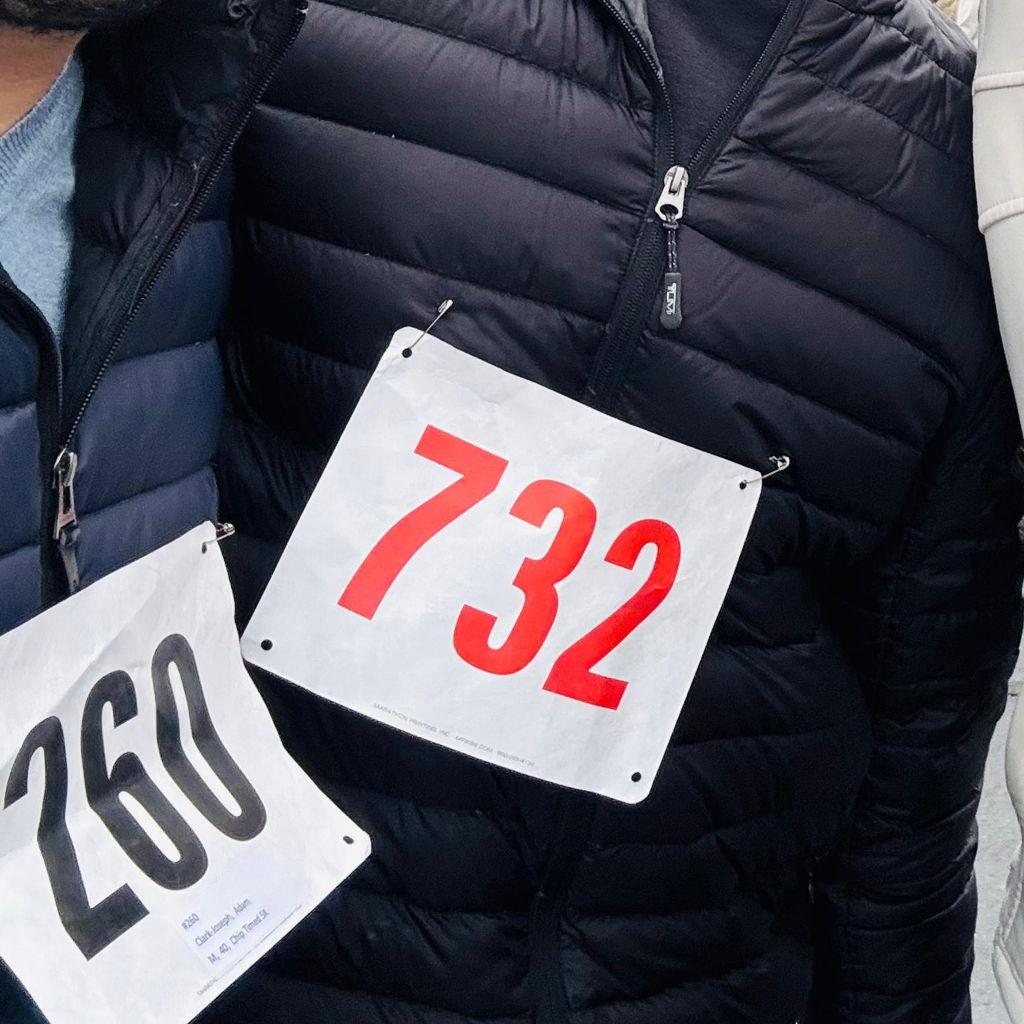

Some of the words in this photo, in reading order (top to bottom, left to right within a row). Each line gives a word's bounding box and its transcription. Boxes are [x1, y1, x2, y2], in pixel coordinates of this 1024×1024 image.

[338, 424, 682, 711] 732
[3, 632, 268, 961] 260
[181, 913, 200, 930] #260
